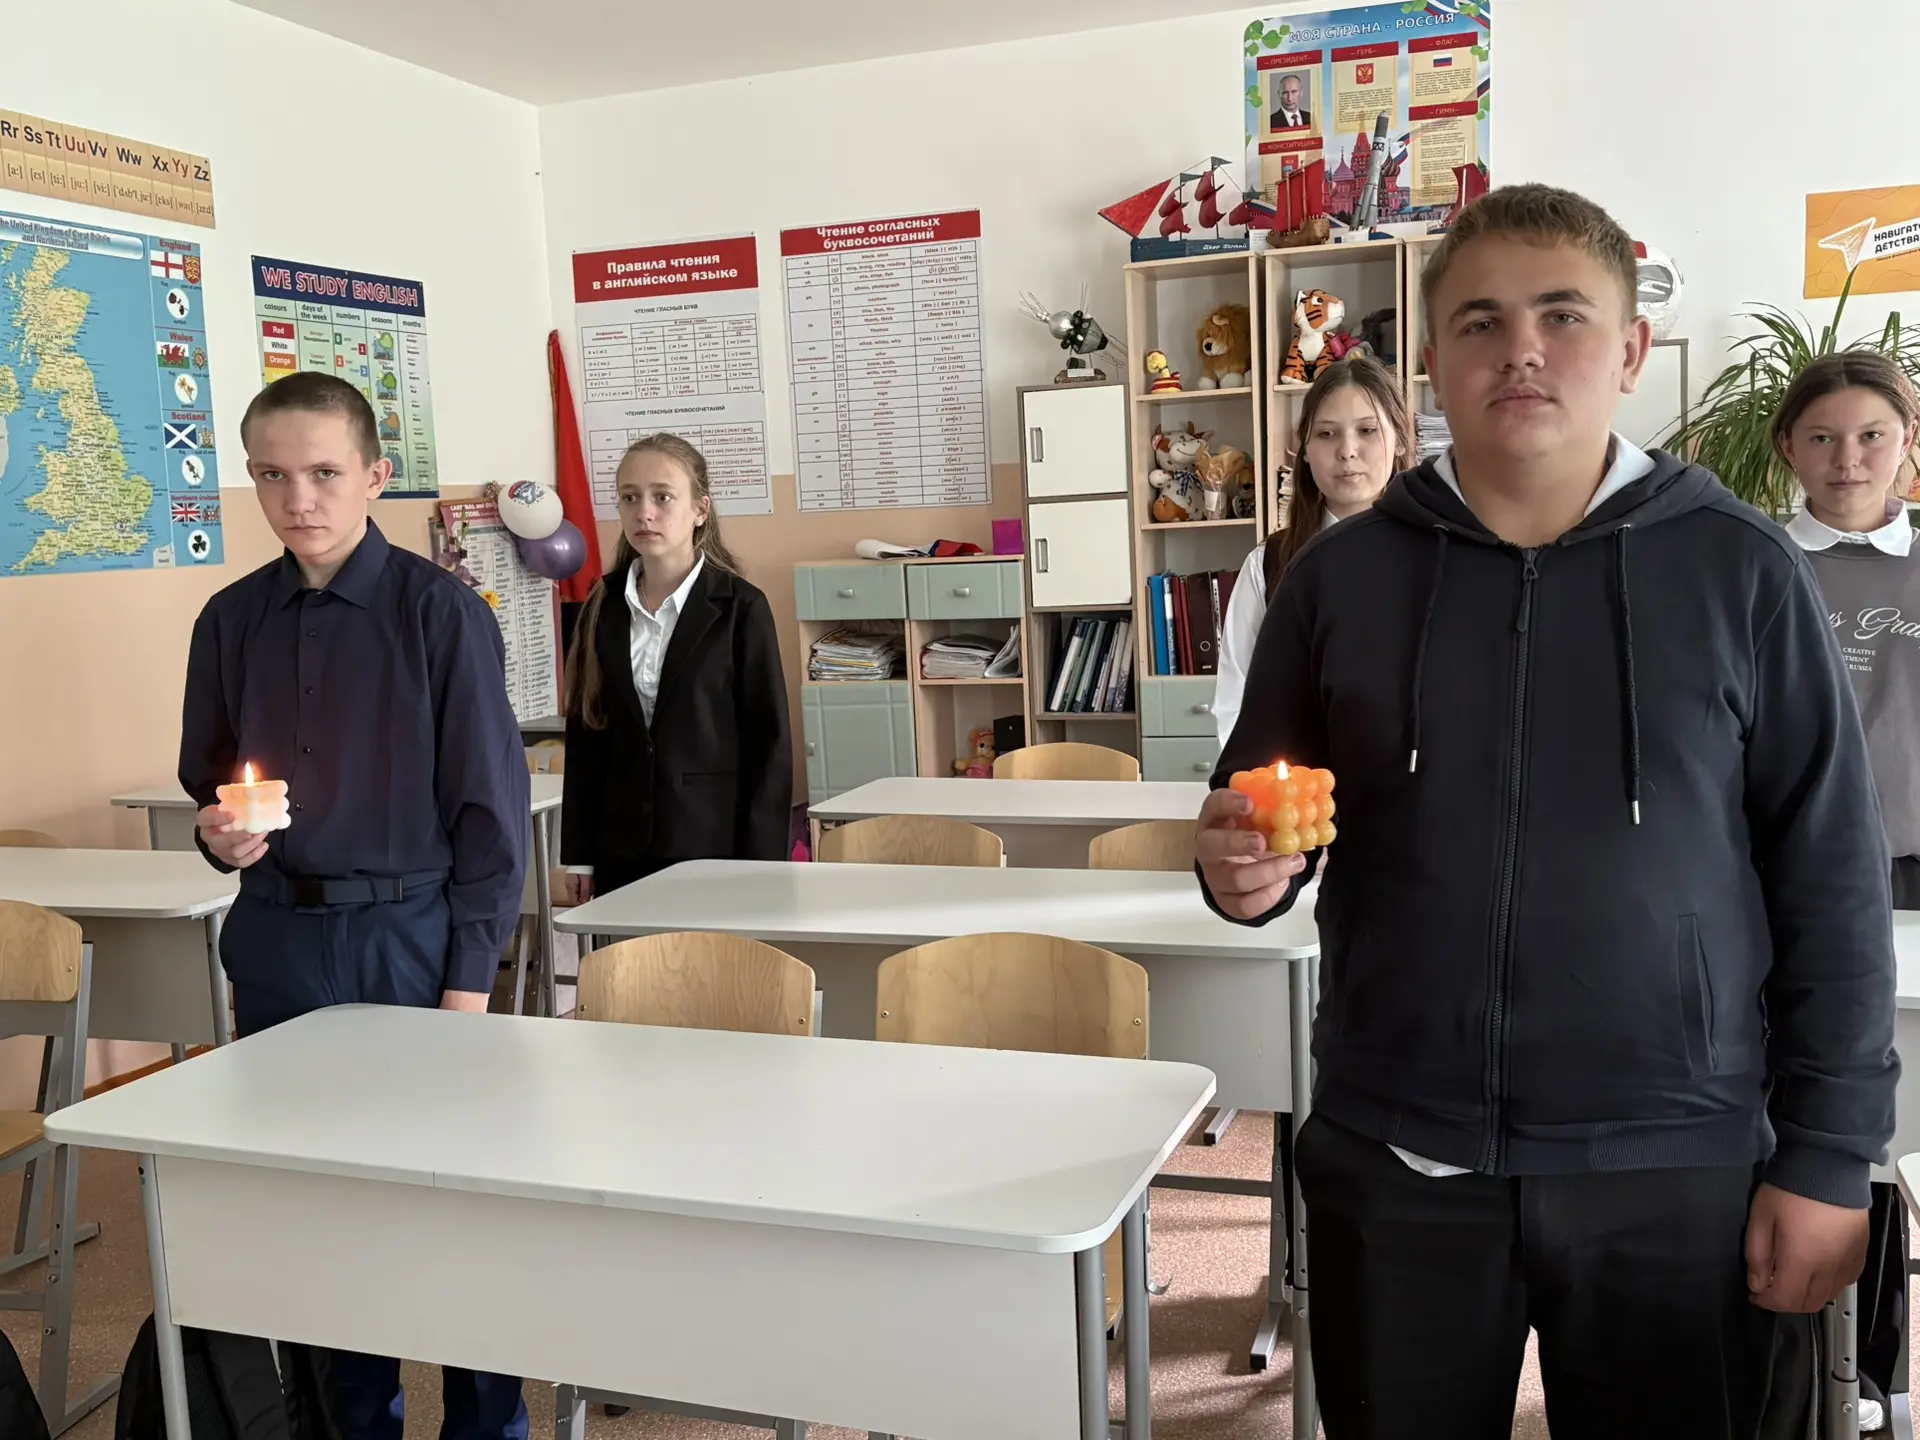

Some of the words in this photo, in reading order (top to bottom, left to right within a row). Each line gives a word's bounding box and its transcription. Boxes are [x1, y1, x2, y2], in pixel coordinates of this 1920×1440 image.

[1289, 29, 1321, 43] МОЯ
[1325, 23, 1381, 39] СТРАНА
[1396, 13, 1456, 30] РОССИЯ
[1435, 38, 1454, 46] ФЛАГ
[1270, 55, 1309, 66] ПРЕЗИДЕНТ
[1435, 107, 1455, 115] ГИМН
[1267, 140, 1316, 151] КОНСТИТУЦИЯ
[1, 120, 19, 139] Rr
[24, 126, 43, 144] Ss
[46, 131, 61, 149] Tt
[65, 136, 86, 154] Uu
[88, 140, 107, 159] Vv
[116, 146, 142, 166] Ww
[152, 155, 170, 173] Xx
[172, 158, 189, 179] Yy
[194, 165, 210, 182] Zz
[10, 219, 33, 231] United
[34, 224, 64, 237] Kingdom
[817, 225, 865, 239] Чтение
[868, 217, 940, 234] согласных
[1874, 223, 1920, 242] НАВИГАТ
[824, 227, 935, 251] буквосочетаний
[1875, 234, 1919, 254] ДЕТСТВА
[159, 239, 192, 251] England
[607, 258, 666, 275] Правила
[671, 254, 720, 267] чтения
[593, 281, 601, 290] в
[604, 273, 688, 289] английском
[692, 269, 738, 281] языке
[261, 265, 292, 290] WE
[296, 271, 348, 297] STUDY
[353, 280, 418, 307] ENGLISH
[264, 303, 287, 312] colours
[302, 304, 315, 314] days
[634, 307, 655, 315] ЧТЕНИЕ
[336, 312, 360, 321] numbers
[372, 316, 393, 325] seasons
[403, 320, 421, 328] months
[272, 326, 285, 334] Red
[169, 331, 194, 342] Wales
[271, 341, 288, 350] White
[269, 355, 291, 365] Orange
[647, 407, 673, 416] ГЛАСНЫХ
[674, 405, 725, 414] БУКВОСОЧЕТАНИЙ
[171, 411, 206, 421] Scotland
[1843, 647, 1876, 656] CREATIVE
[1843, 655, 1869, 663] TMENT
[1849, 664, 1872, 672] RUSSIA
